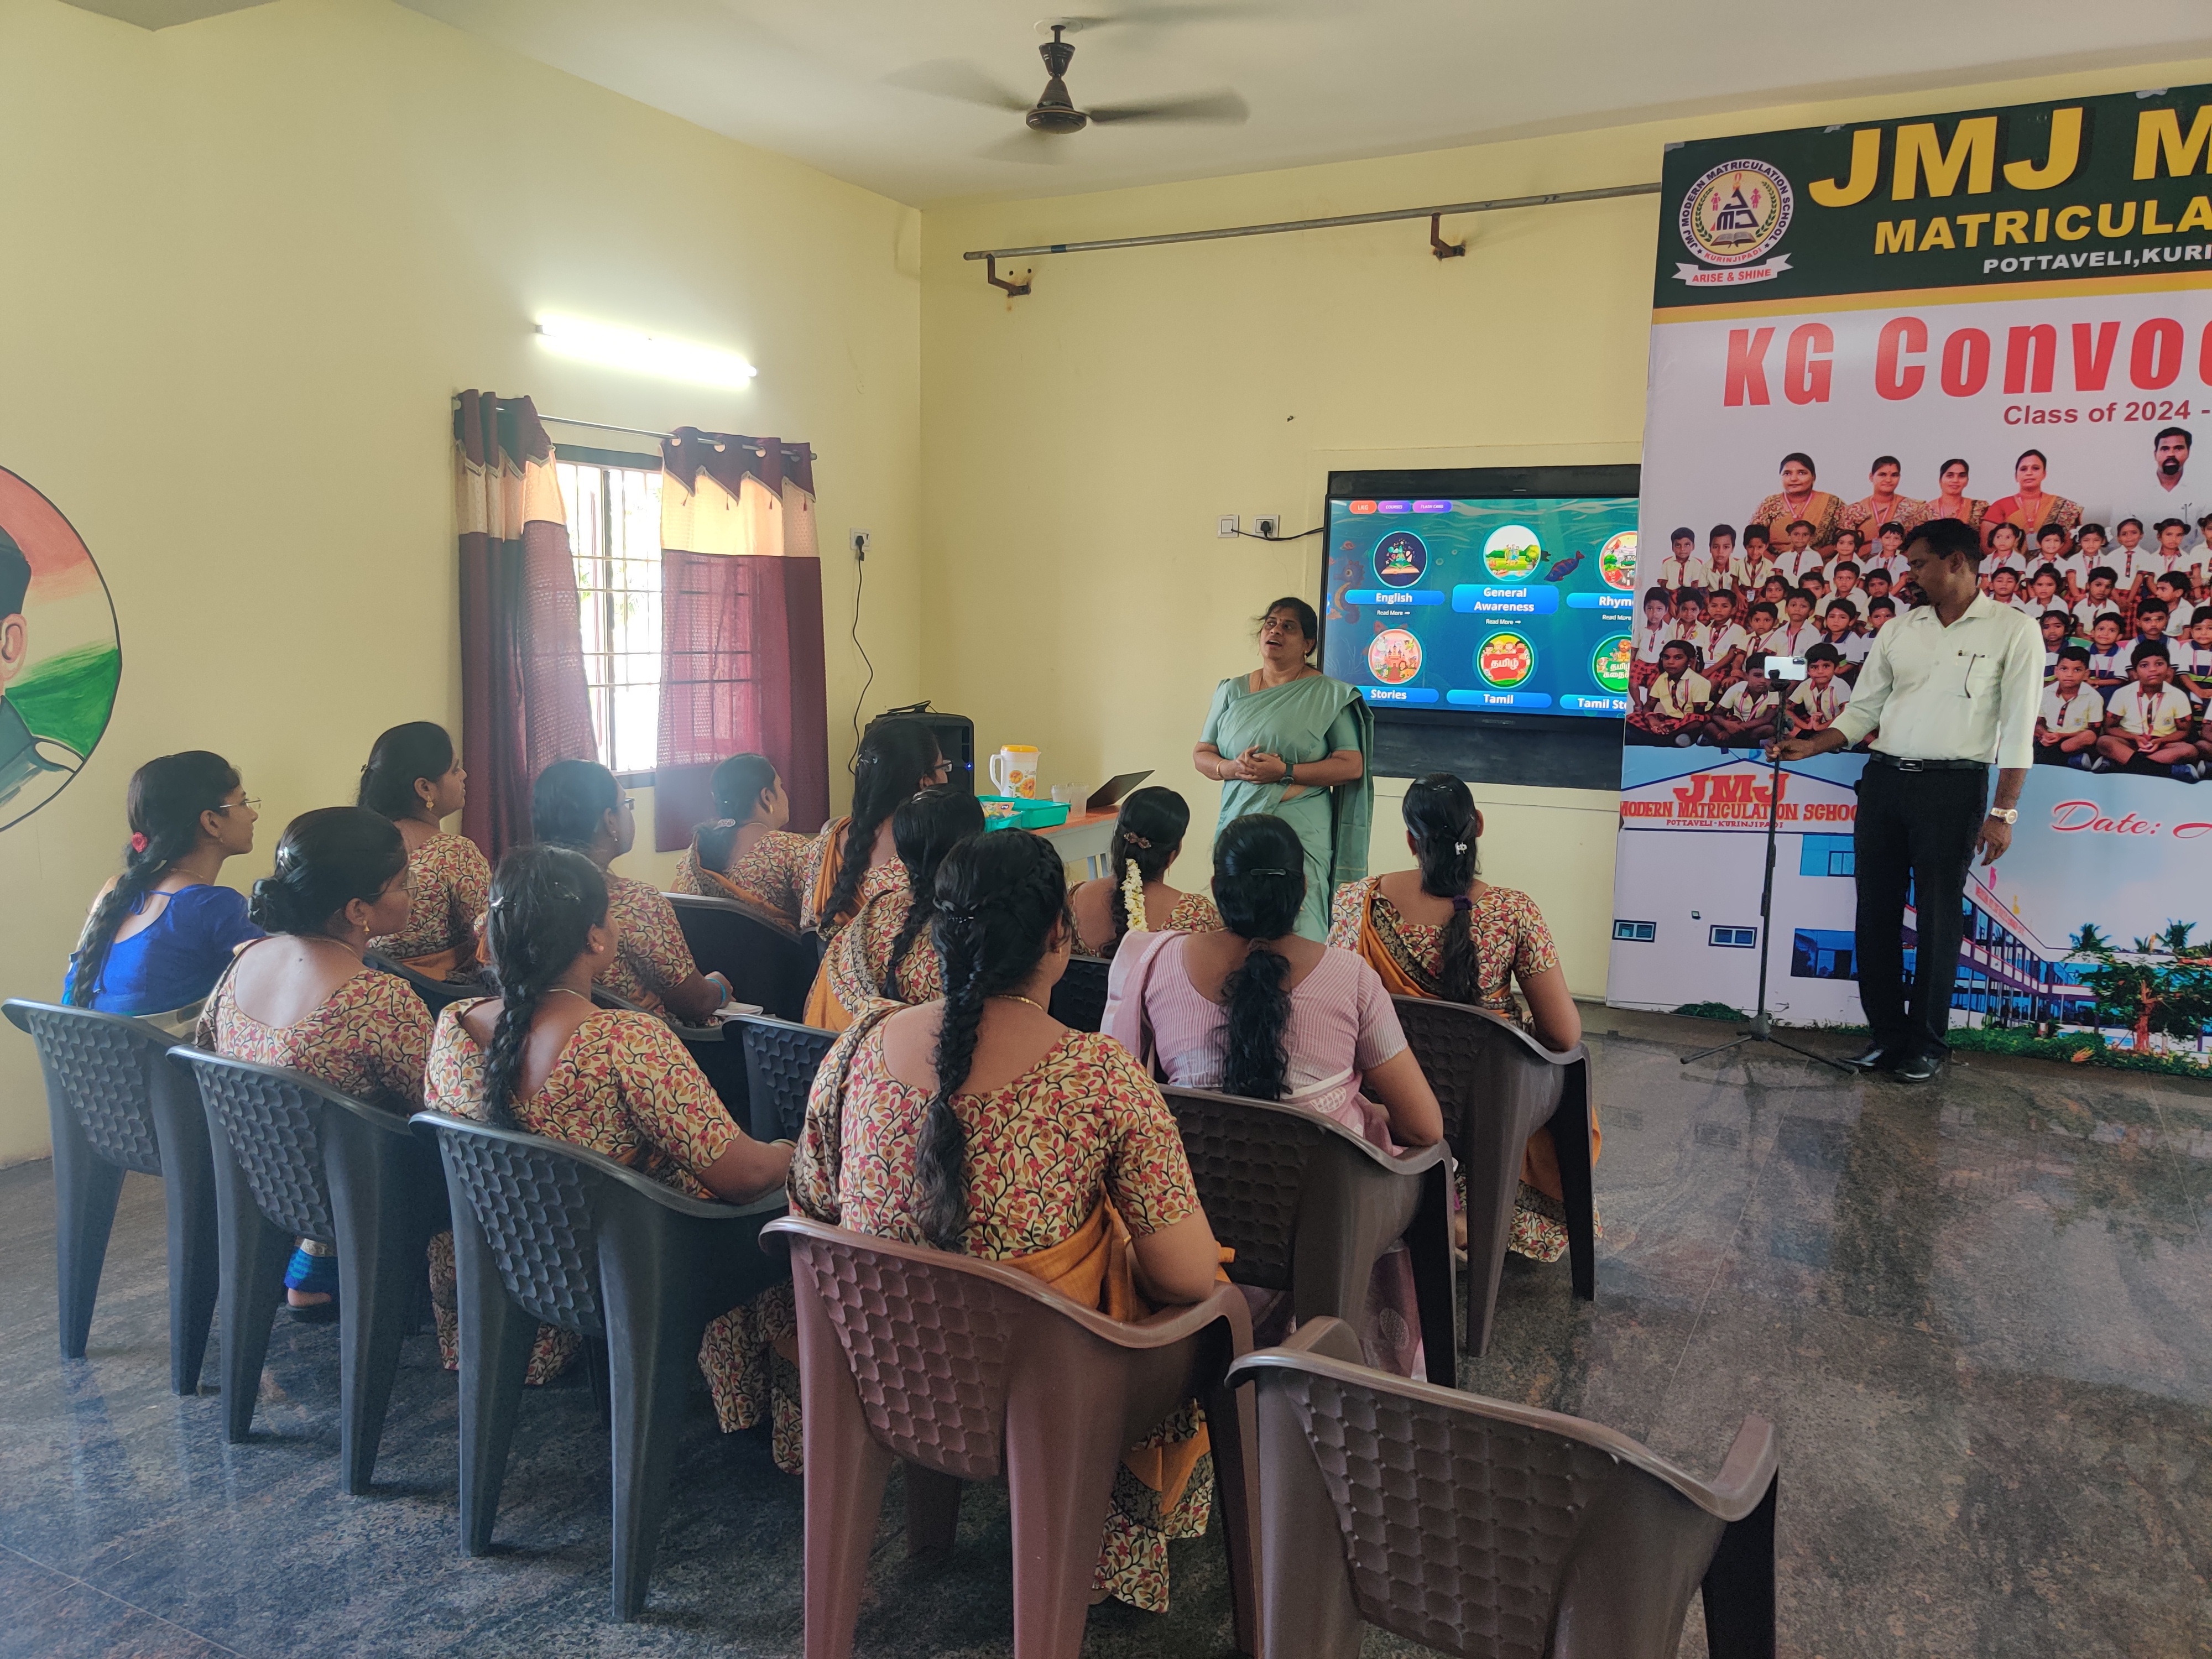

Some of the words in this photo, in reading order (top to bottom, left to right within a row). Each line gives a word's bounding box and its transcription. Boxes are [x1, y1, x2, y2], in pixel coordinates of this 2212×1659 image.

[1809, 107, 2083, 207] JMJ
[1706, 161, 1789, 195] MATRICULATION
[1682, 180, 1706, 227] MODERN
[1768, 197, 1791, 241] SCHOOL
[1874, 195, 2212, 255] MATRICULA
[1683, 231, 1698, 249] JMJ
[1704, 247, 1762, 263] KURINJIPADI
[1692, 272, 1724, 283] ARISE
[1727, 272, 1734, 281] &
[1738, 269, 1772, 280] SHINE
[1723, 322, 1835, 408] KG
[1874, 316, 2212, 401] Convo
[2004, 405, 2078, 425] Class
[2089, 402, 2118, 422] of
[2124, 399, 2191, 422] 2024
[1376, 592, 1413, 604] English
[1483, 587, 1527, 597] General
[1474, 601, 1535, 612] Awareness
[1599, 596, 1634, 609] Rhym
[1491, 658, 1519, 670] தமிழ்
[1370, 689, 1407, 700] Stories
[1483, 694, 1514, 704] Tamil
[1577, 698, 1610, 709] Tamil
[1673, 774, 1790, 804] JMJ
[1620, 801, 1673, 817] MODERN
[1677, 802, 1799, 820] MATRICULATON
[2052, 801, 2161, 835] Date:
[1666, 819, 1713, 827] POTTAVELI
